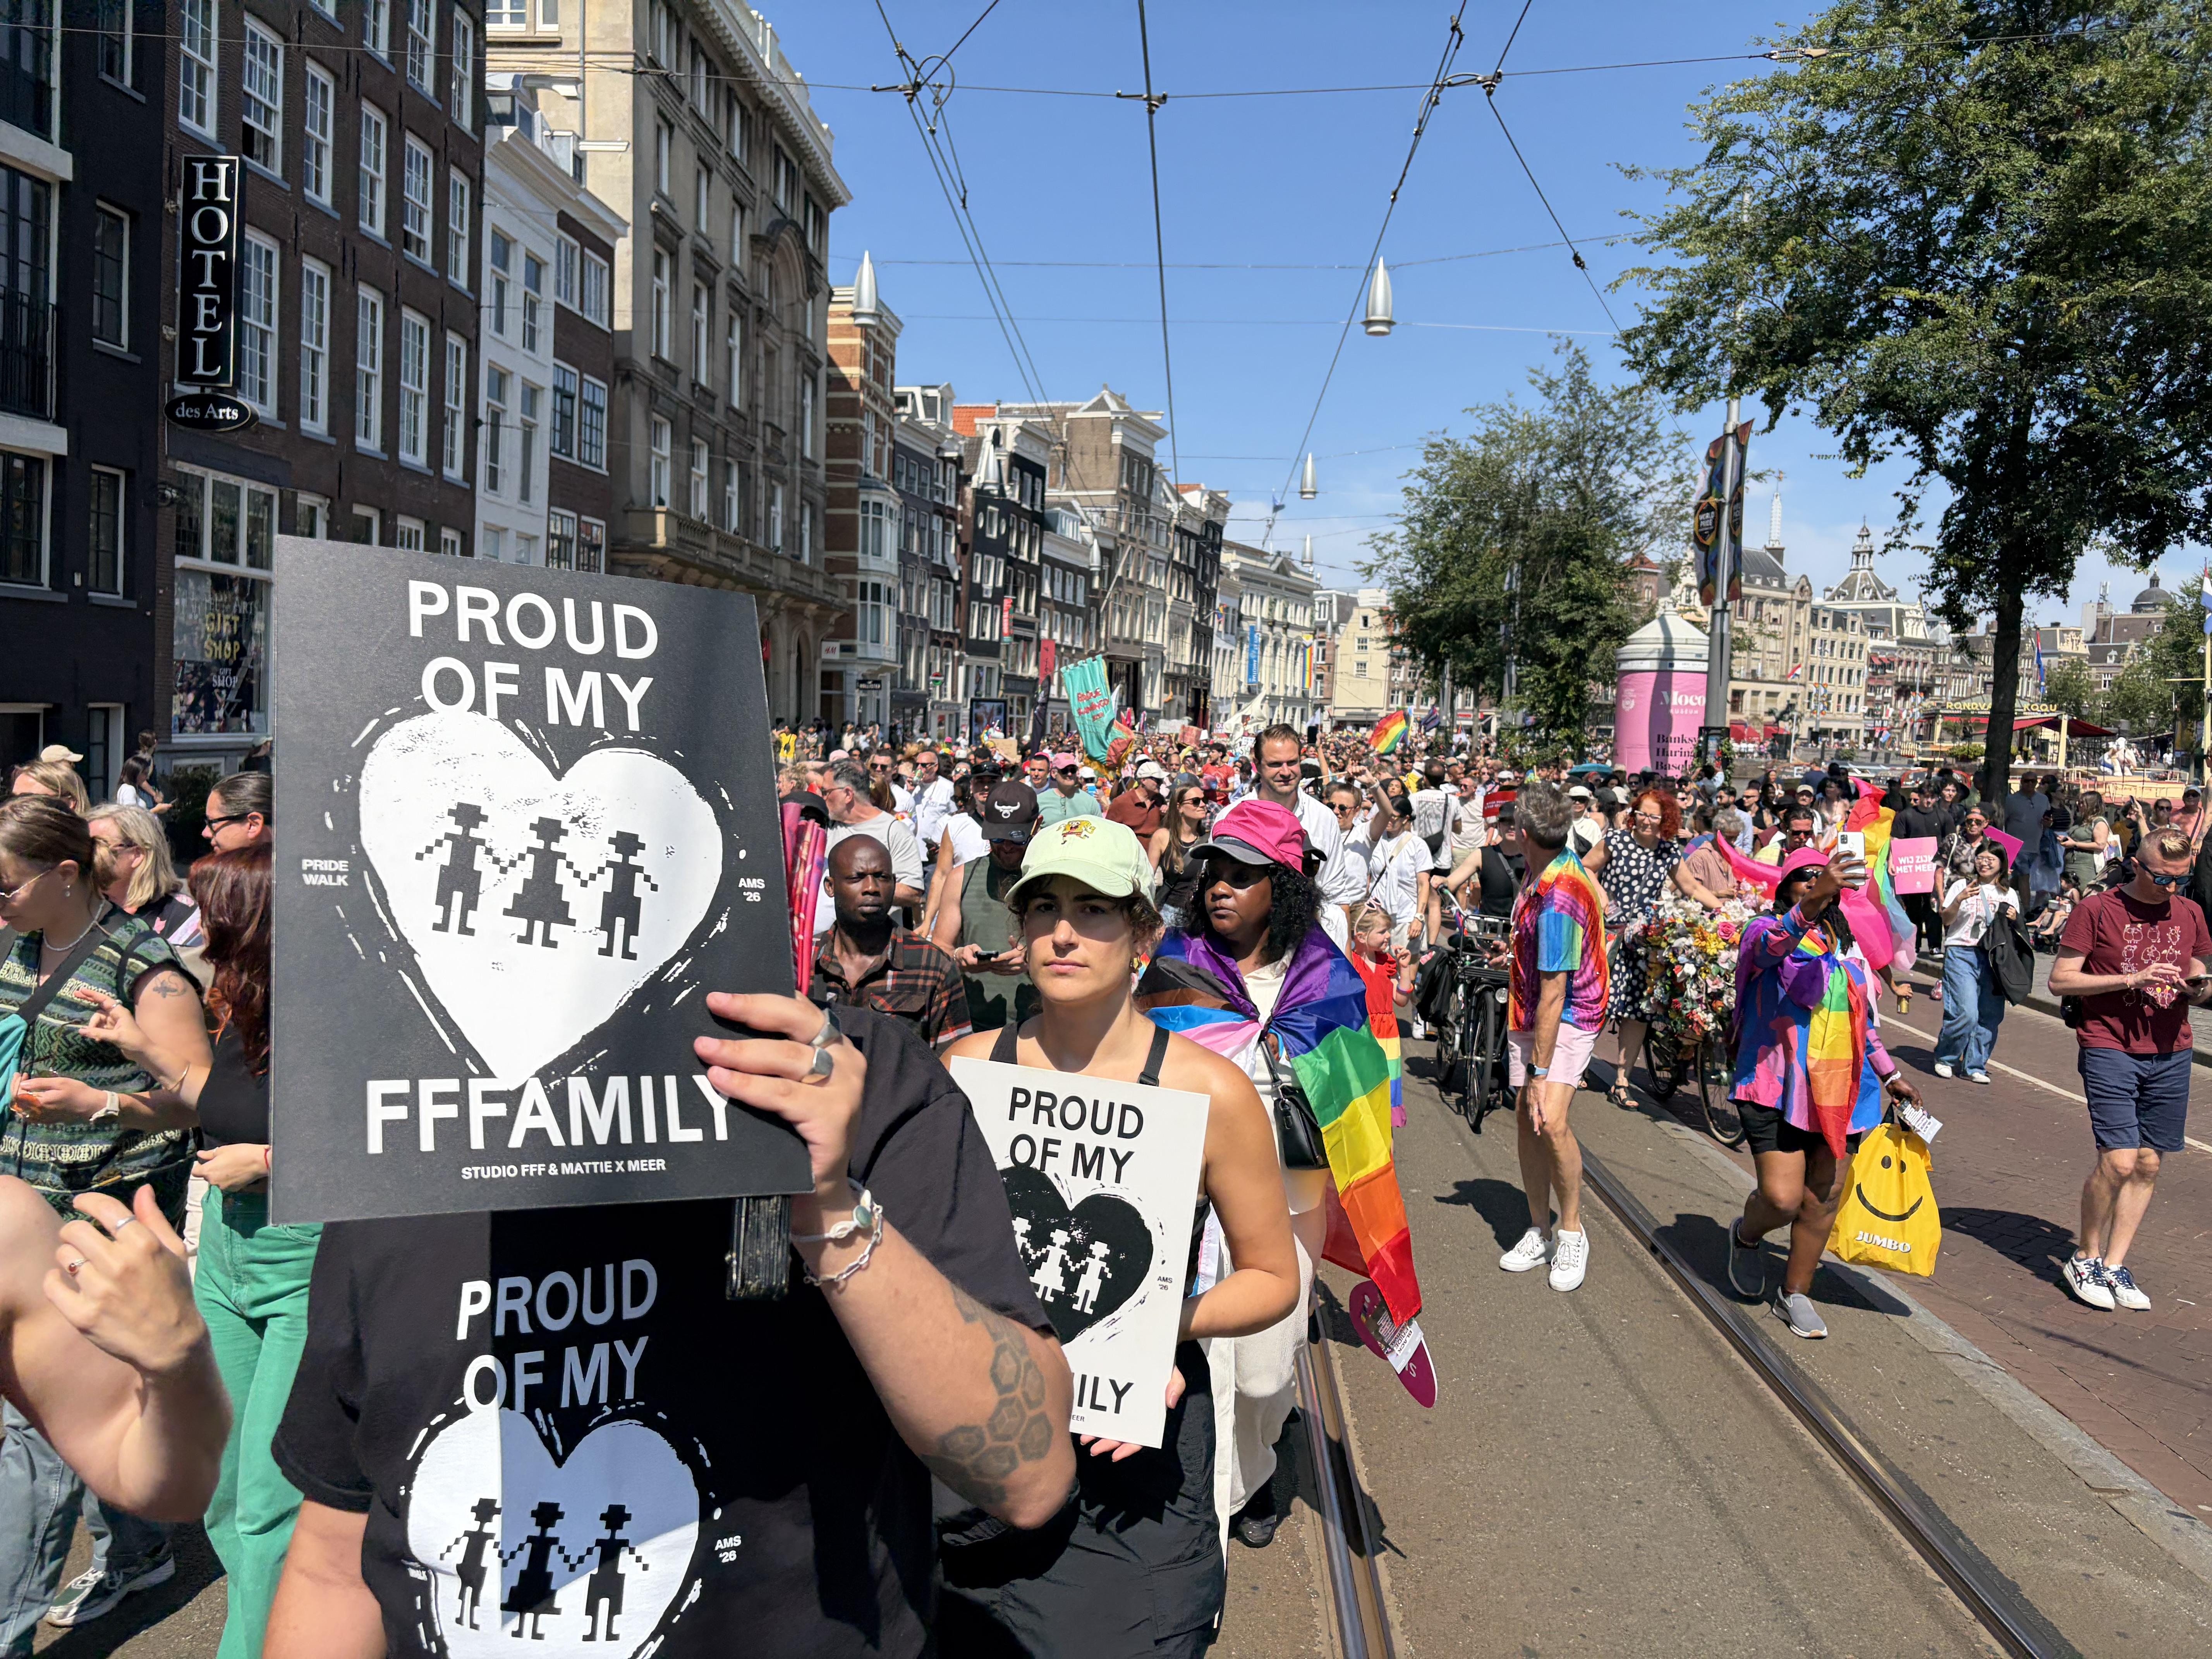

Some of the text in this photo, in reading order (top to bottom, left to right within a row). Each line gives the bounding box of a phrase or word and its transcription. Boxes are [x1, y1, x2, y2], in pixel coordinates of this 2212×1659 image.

[192, 162, 231, 376] HOTEL
[175, 403, 239, 421] des Arts
[205, 612, 240, 635] GIFT
[409, 580, 658, 660] PROUD
[204, 640, 240, 661] SHOP
[421, 657, 654, 731] OF MY
[302, 859, 349, 873] PRIDE
[1896, 865, 1913, 874] MET
[1898, 856, 1914, 865] WIJ
[302, 873, 349, 887] WALK
[738, 878, 766, 889] AMS
[367, 1074, 730, 1154] FFFAMILY
[1008, 1087, 1144, 1139] PROUD
[461, 1158, 666, 1180] STUDIO FFF & MATTIE X MEER
[1009, 1133, 1135, 1183] OF MY
[1855, 1230, 1911, 1253] JUMBO
[1157, 1276, 1173, 1285] AMS
[456, 1259, 658, 1340] PROUD
[463, 1336, 649, 1413] OF MY
[1072, 1372, 1135, 1414] ILY
[715, 1535, 742, 1549] AMS
